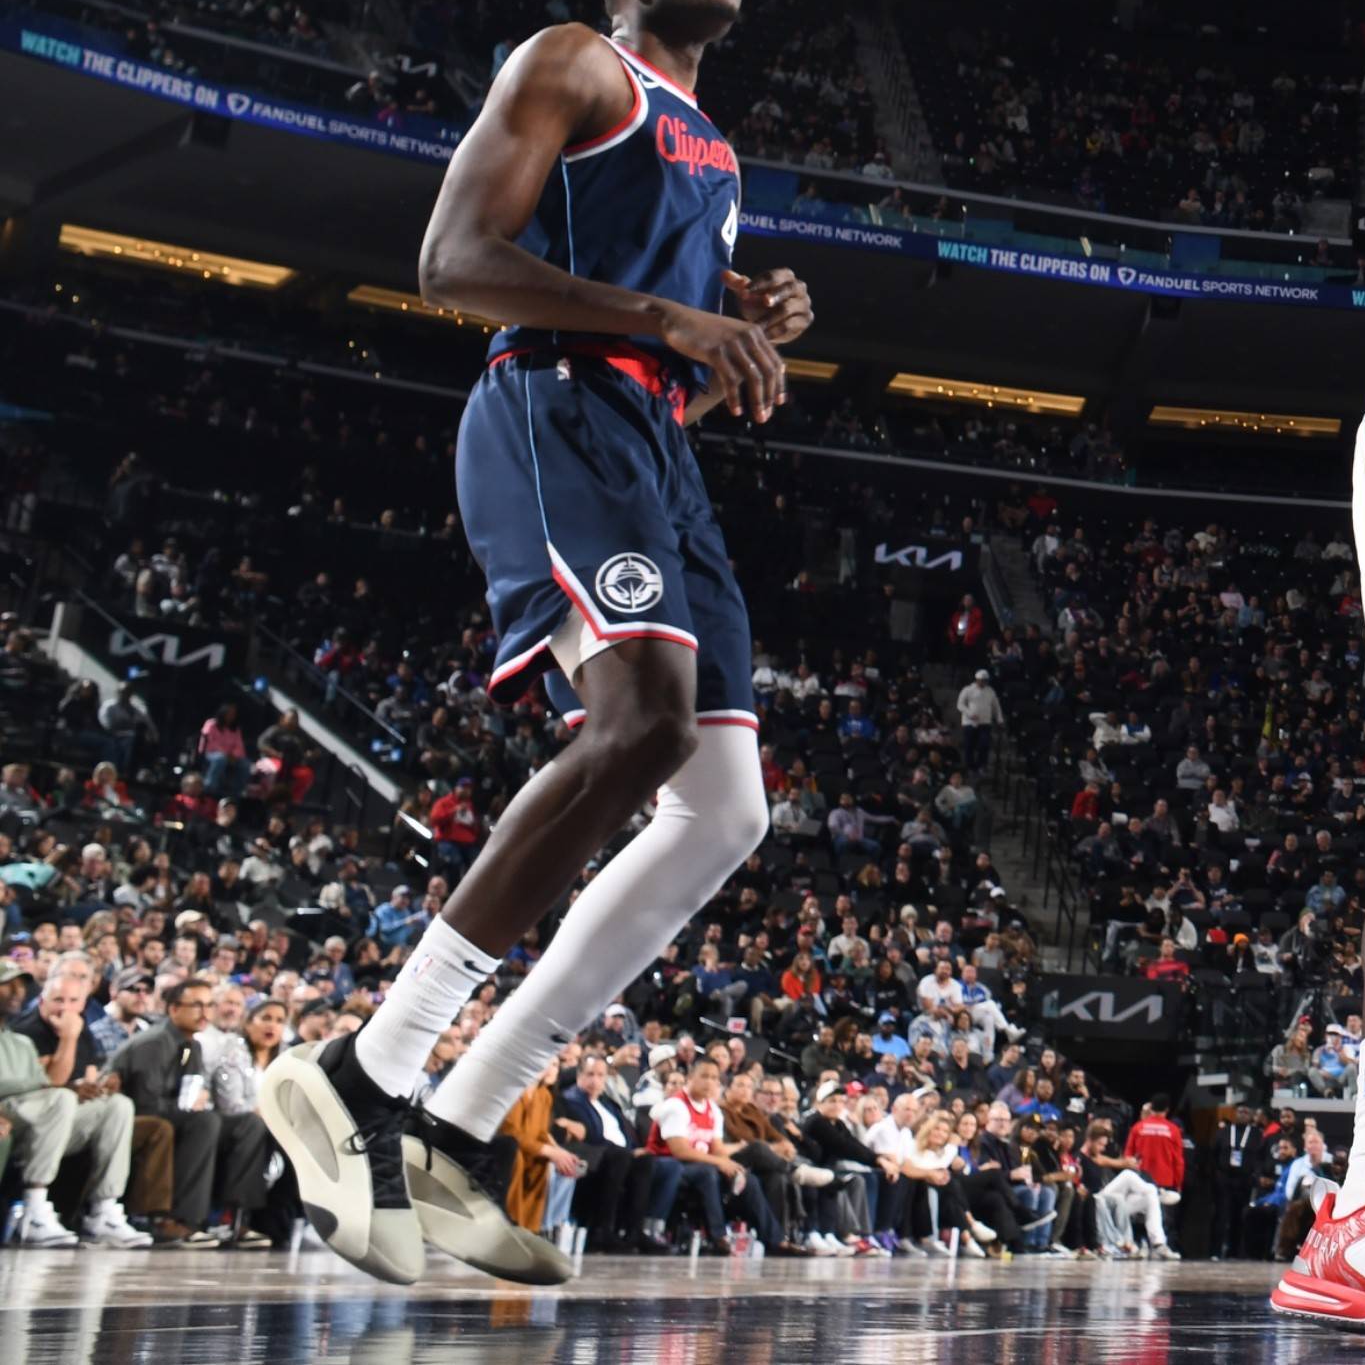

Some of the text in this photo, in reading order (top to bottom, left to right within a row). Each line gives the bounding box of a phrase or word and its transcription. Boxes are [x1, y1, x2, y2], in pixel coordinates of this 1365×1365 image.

[21, 29, 453, 161] WATCH THE CLIPPERS ON FANDUEL SPORTS NETWOR
[738, 211, 903, 249] DUEL SPORTS NETWORK
[938, 240, 988, 264] WATCH
[990, 249, 1017, 267] THE
[1020, 253, 1088, 279] CLIPPERS
[1089, 264, 1110, 282] ON
[1138, 273, 1200, 291] FANDUEL
[1202, 280, 1253, 296] SPORTS
[1254, 284, 1319, 300] NETWORK
[874, 542, 963, 571] KIA
[108, 627, 226, 672] KIA
[1042, 990, 1164, 1024] KIA
